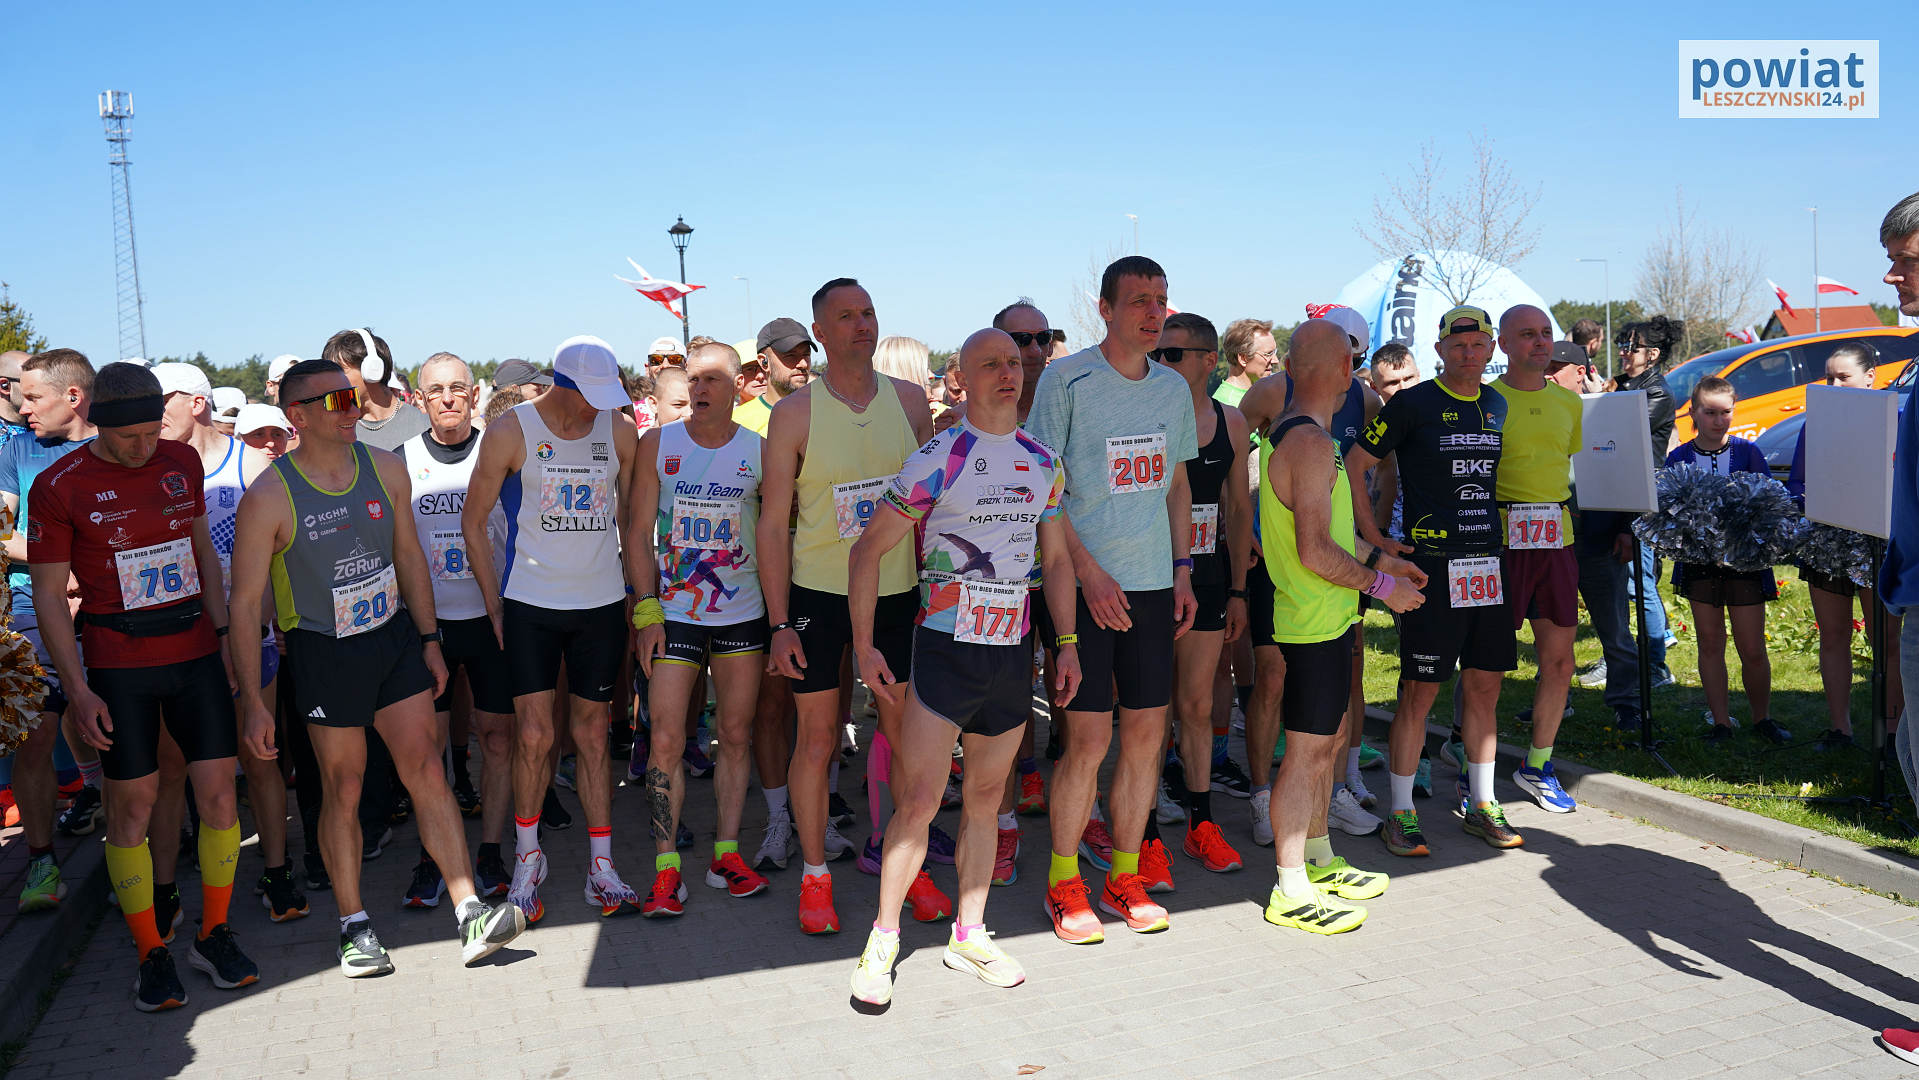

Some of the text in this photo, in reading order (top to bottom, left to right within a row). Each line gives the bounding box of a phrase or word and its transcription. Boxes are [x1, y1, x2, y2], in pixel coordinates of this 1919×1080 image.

[1450, 433, 1500, 446] REAL
[1114, 453, 1164, 487] 209
[1452, 459, 1495, 475] BIKE
[95, 490, 118, 502] MR
[560, 484, 592, 511] 12
[674, 480, 744, 498] Run Team
[1460, 490, 1490, 500] Enea
[885, 488, 911, 514] REAL
[976, 496, 1024, 506] JERZYK TEAM
[318, 506, 348, 522] KGHM
[541, 514, 606, 532] SANA
[968, 513, 1038, 524] MATEUSZ
[680, 516, 733, 544] 104
[1458, 524, 1492, 532] bauman
[1516, 520, 1557, 544] 178
[334, 556, 383, 581] ZGRun
[140, 562, 183, 599] 76
[1456, 574, 1498, 601] 130
[994, 587, 1015, 595] BORKÓW
[352, 591, 388, 628] 20
[971, 605, 1019, 638] 177
